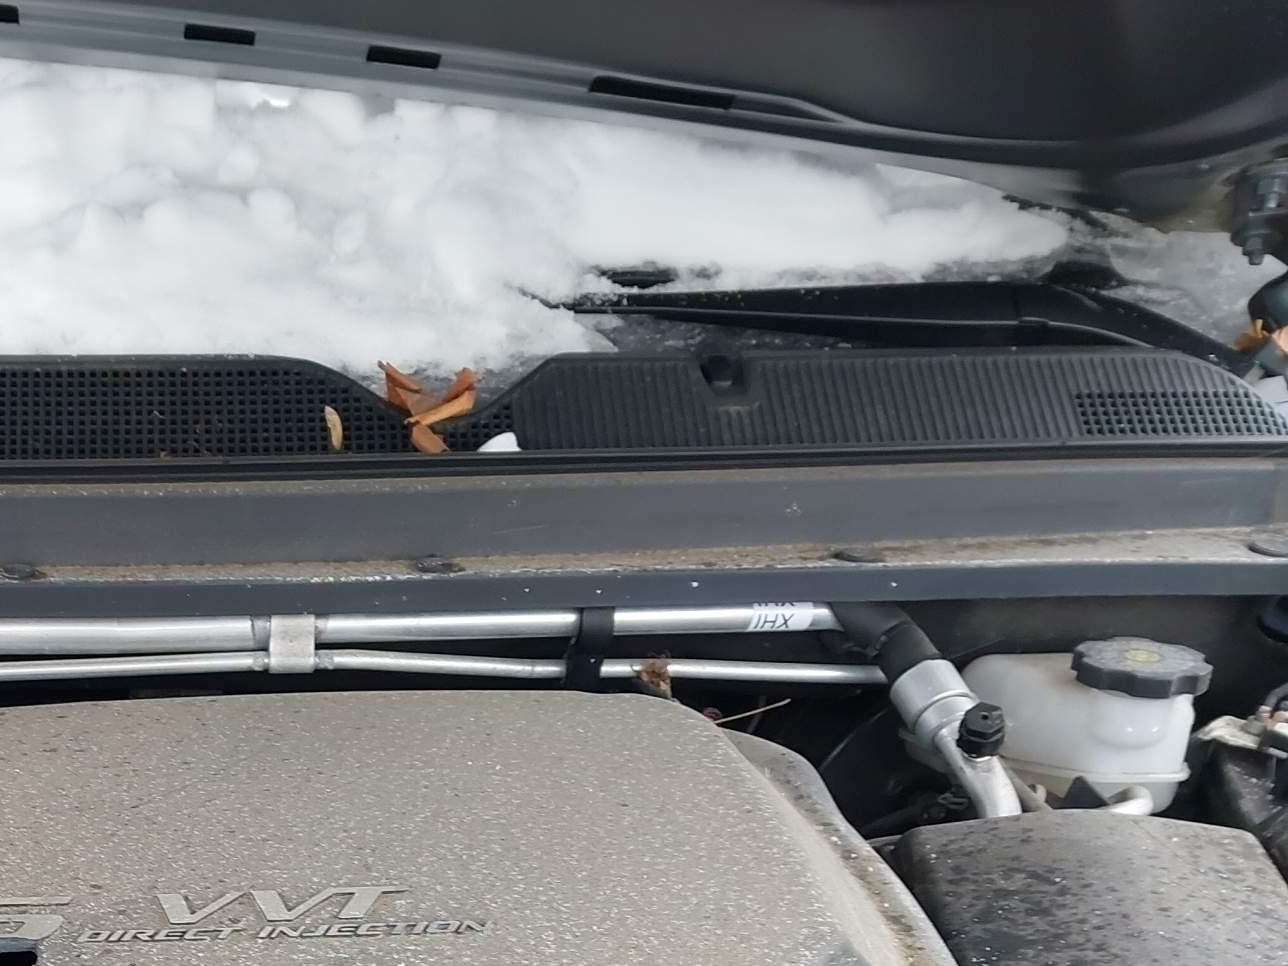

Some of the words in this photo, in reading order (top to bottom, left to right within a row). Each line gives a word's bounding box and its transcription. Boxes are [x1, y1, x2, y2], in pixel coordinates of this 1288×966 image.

[753, 613, 795, 629] IHX
[156, 885, 409, 925] VVT
[76, 927, 243, 943] DIRECT
[256, 920, 492, 940] INJECTION
